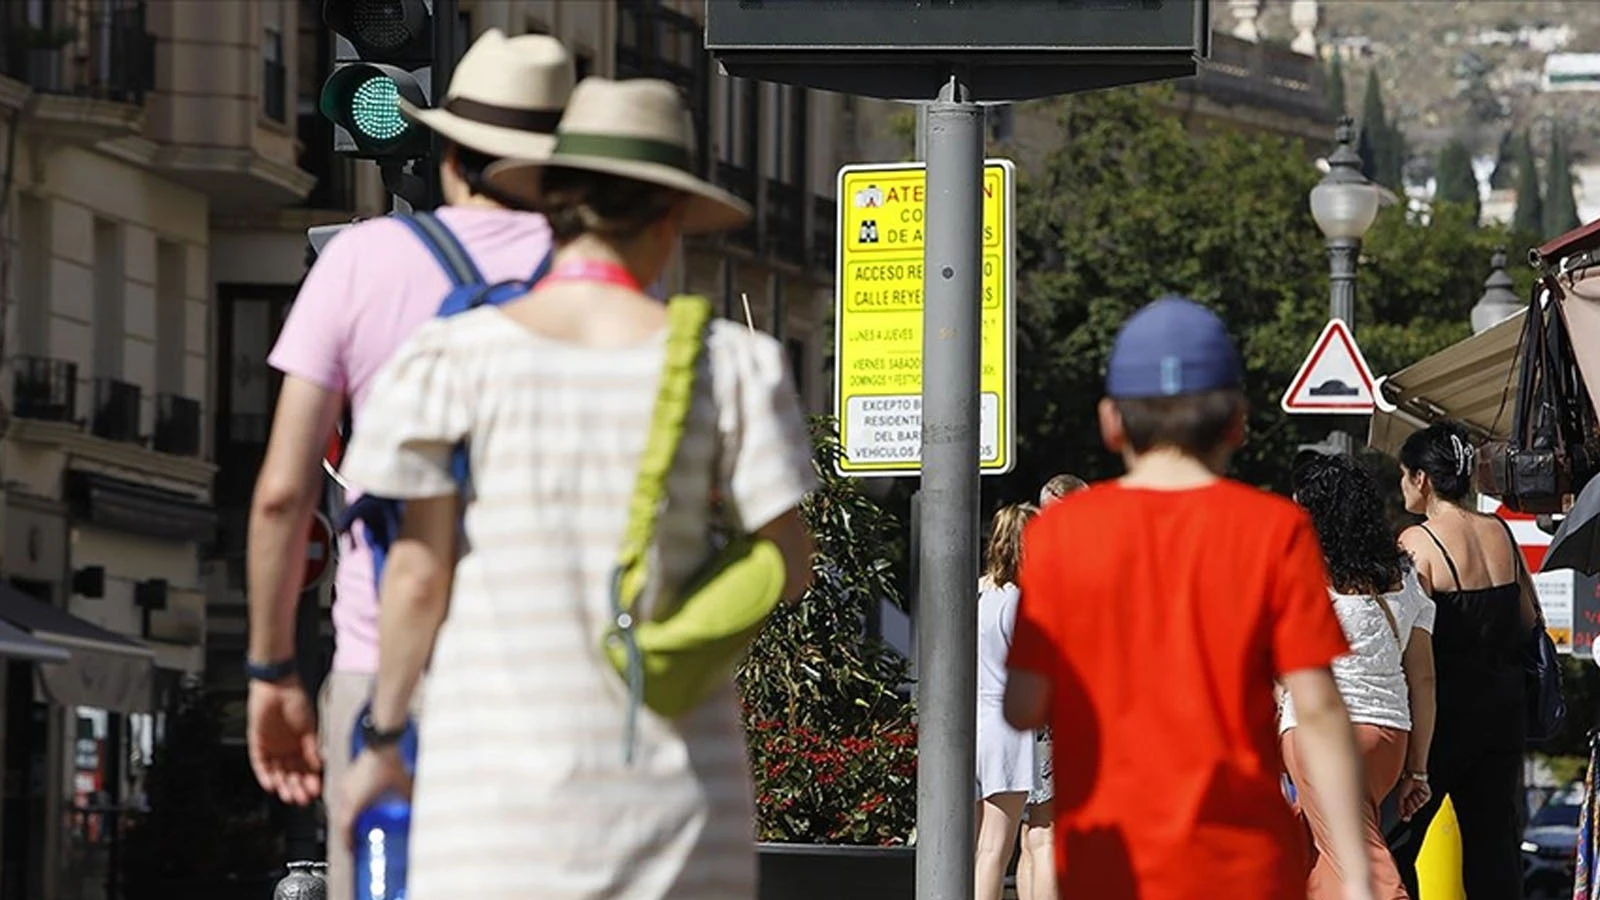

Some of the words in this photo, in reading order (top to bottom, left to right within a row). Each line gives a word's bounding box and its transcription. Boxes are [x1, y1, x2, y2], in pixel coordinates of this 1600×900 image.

[887, 228, 908, 243] DE
[855, 265, 904, 281] ACCESO
[854, 290, 888, 306] CALLE
[892, 288, 922, 305] REYE
[862, 399, 911, 411] EXCEPTO
[864, 415, 921, 427] RESIDENTE
[875, 431, 895, 442] DEL
[897, 430, 920, 442] BAR
